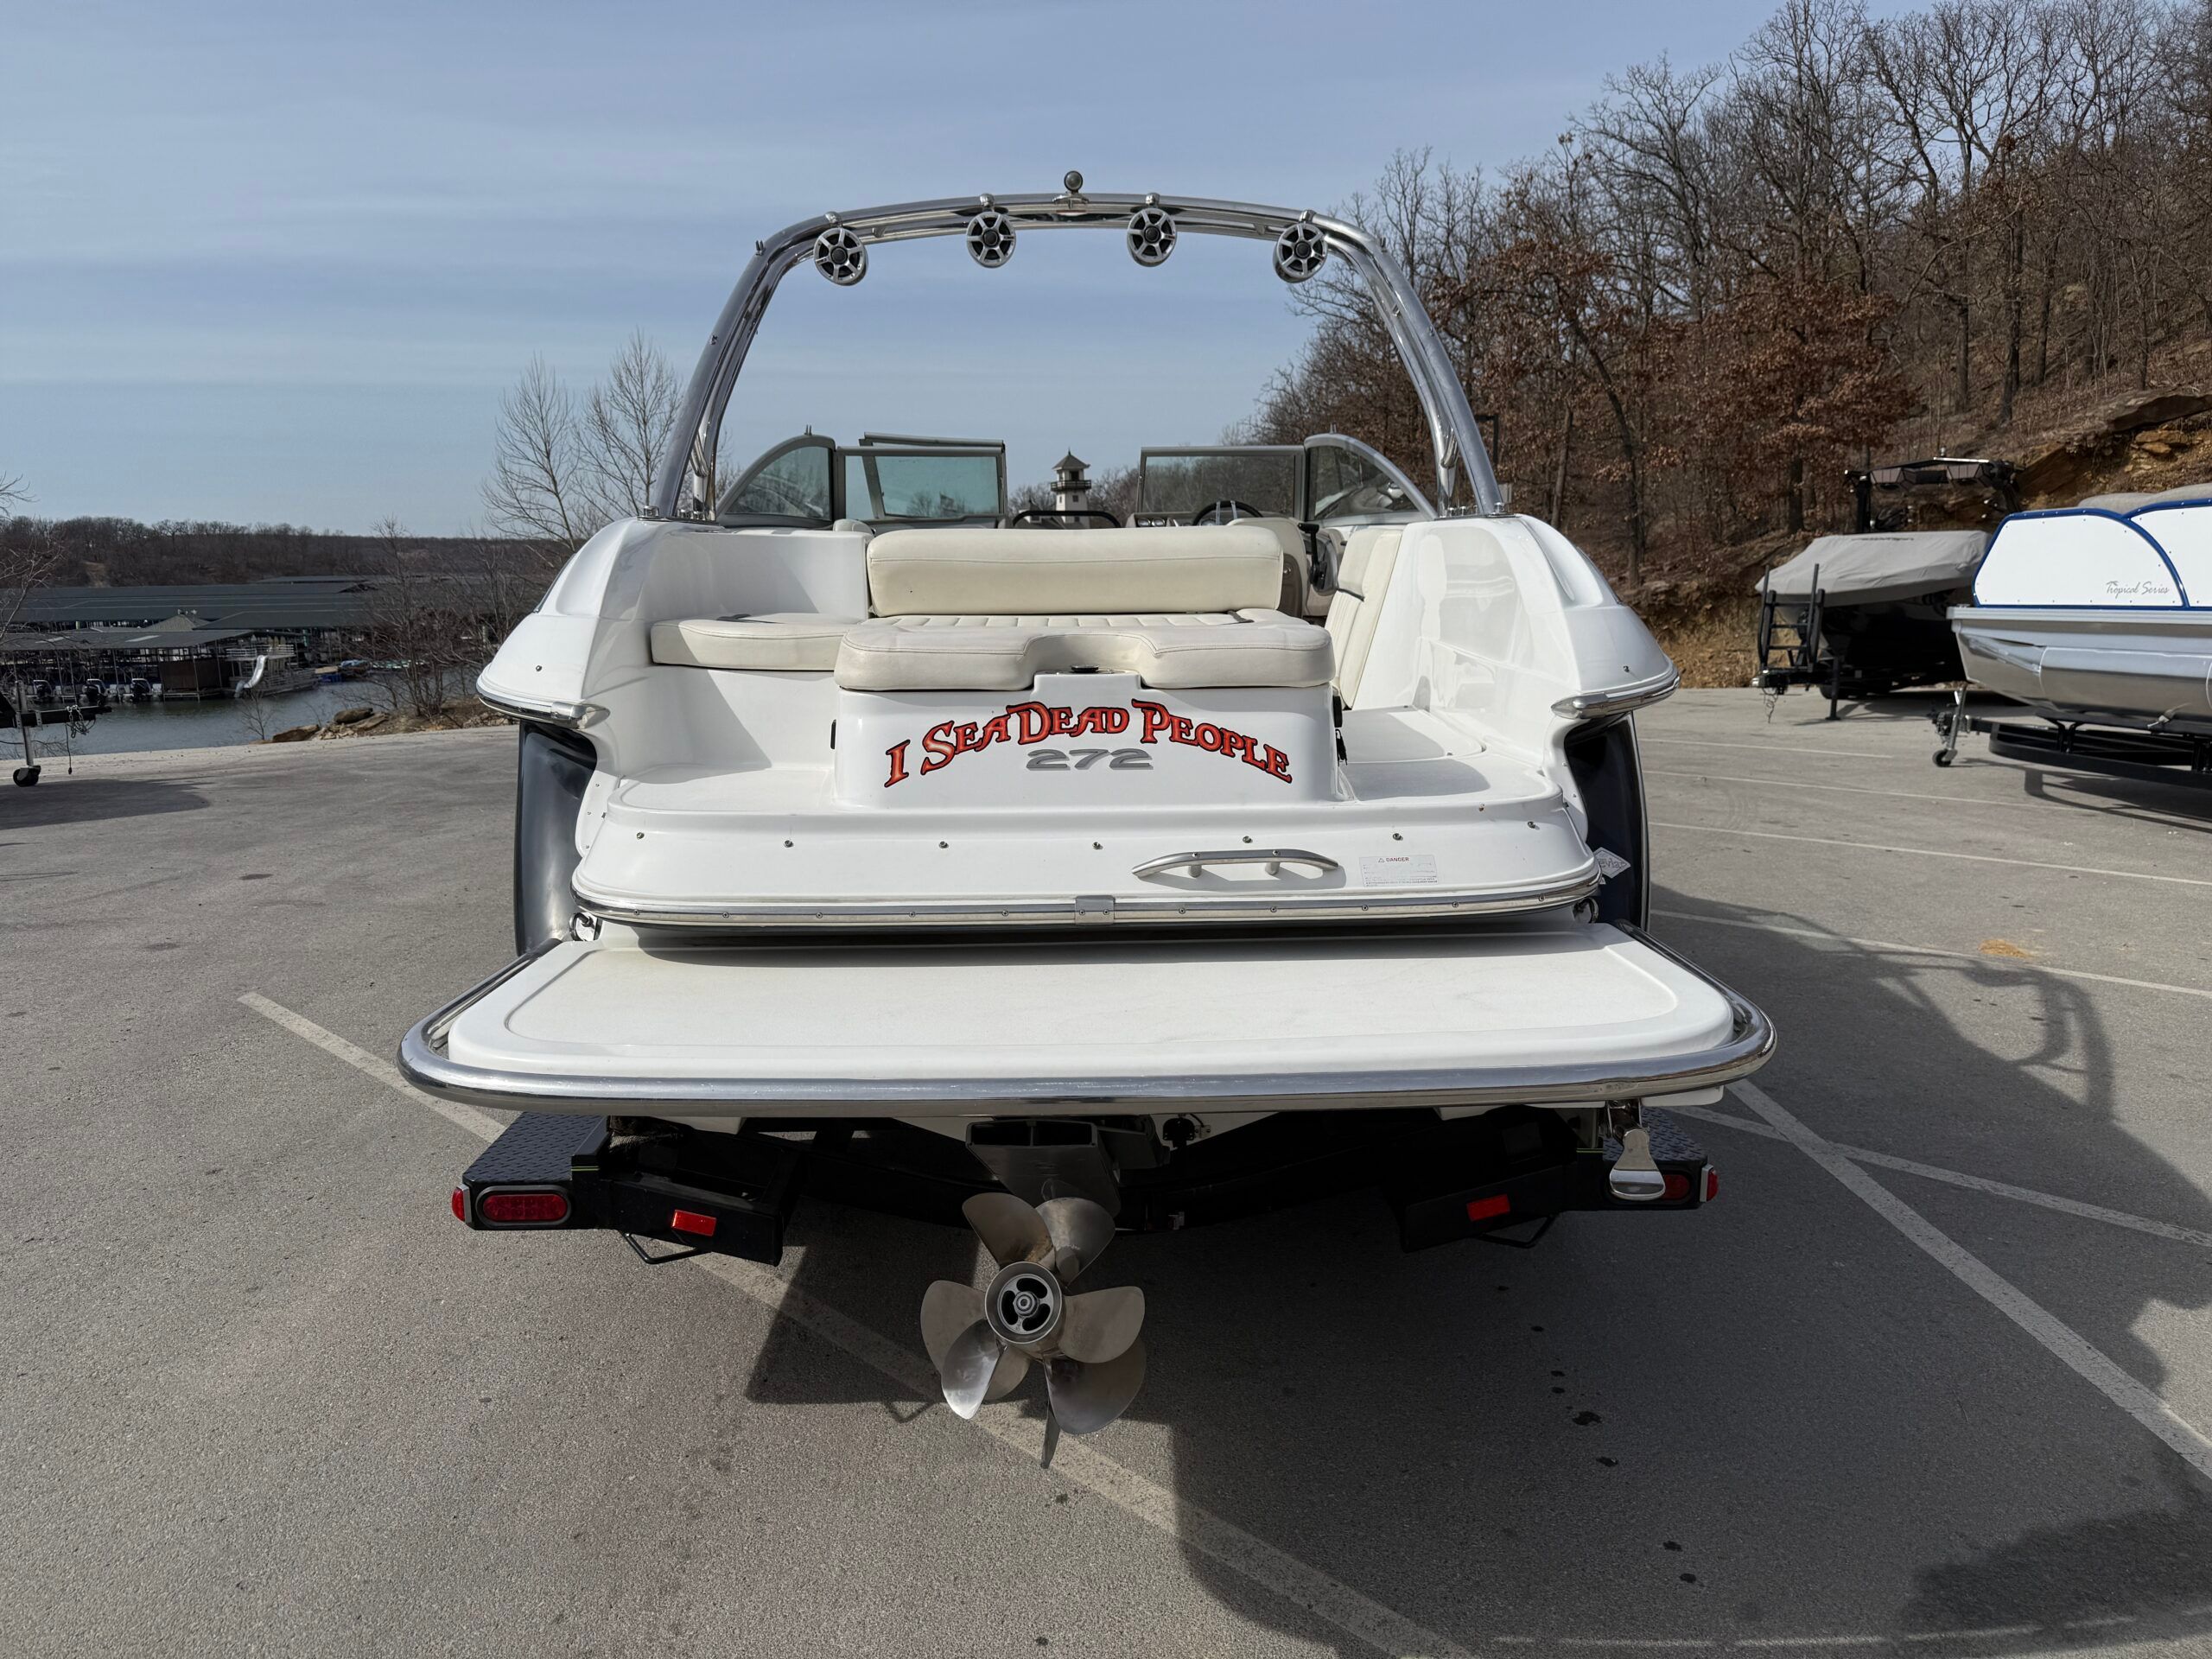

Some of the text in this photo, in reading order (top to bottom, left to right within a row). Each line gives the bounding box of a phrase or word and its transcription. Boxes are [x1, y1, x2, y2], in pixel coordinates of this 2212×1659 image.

[2106, 581, 2170, 599] Tropical Series
[884, 739, 911, 788] I
[1132, 698, 1293, 784] PEOPLE
[1026, 748, 1154, 771] 272
